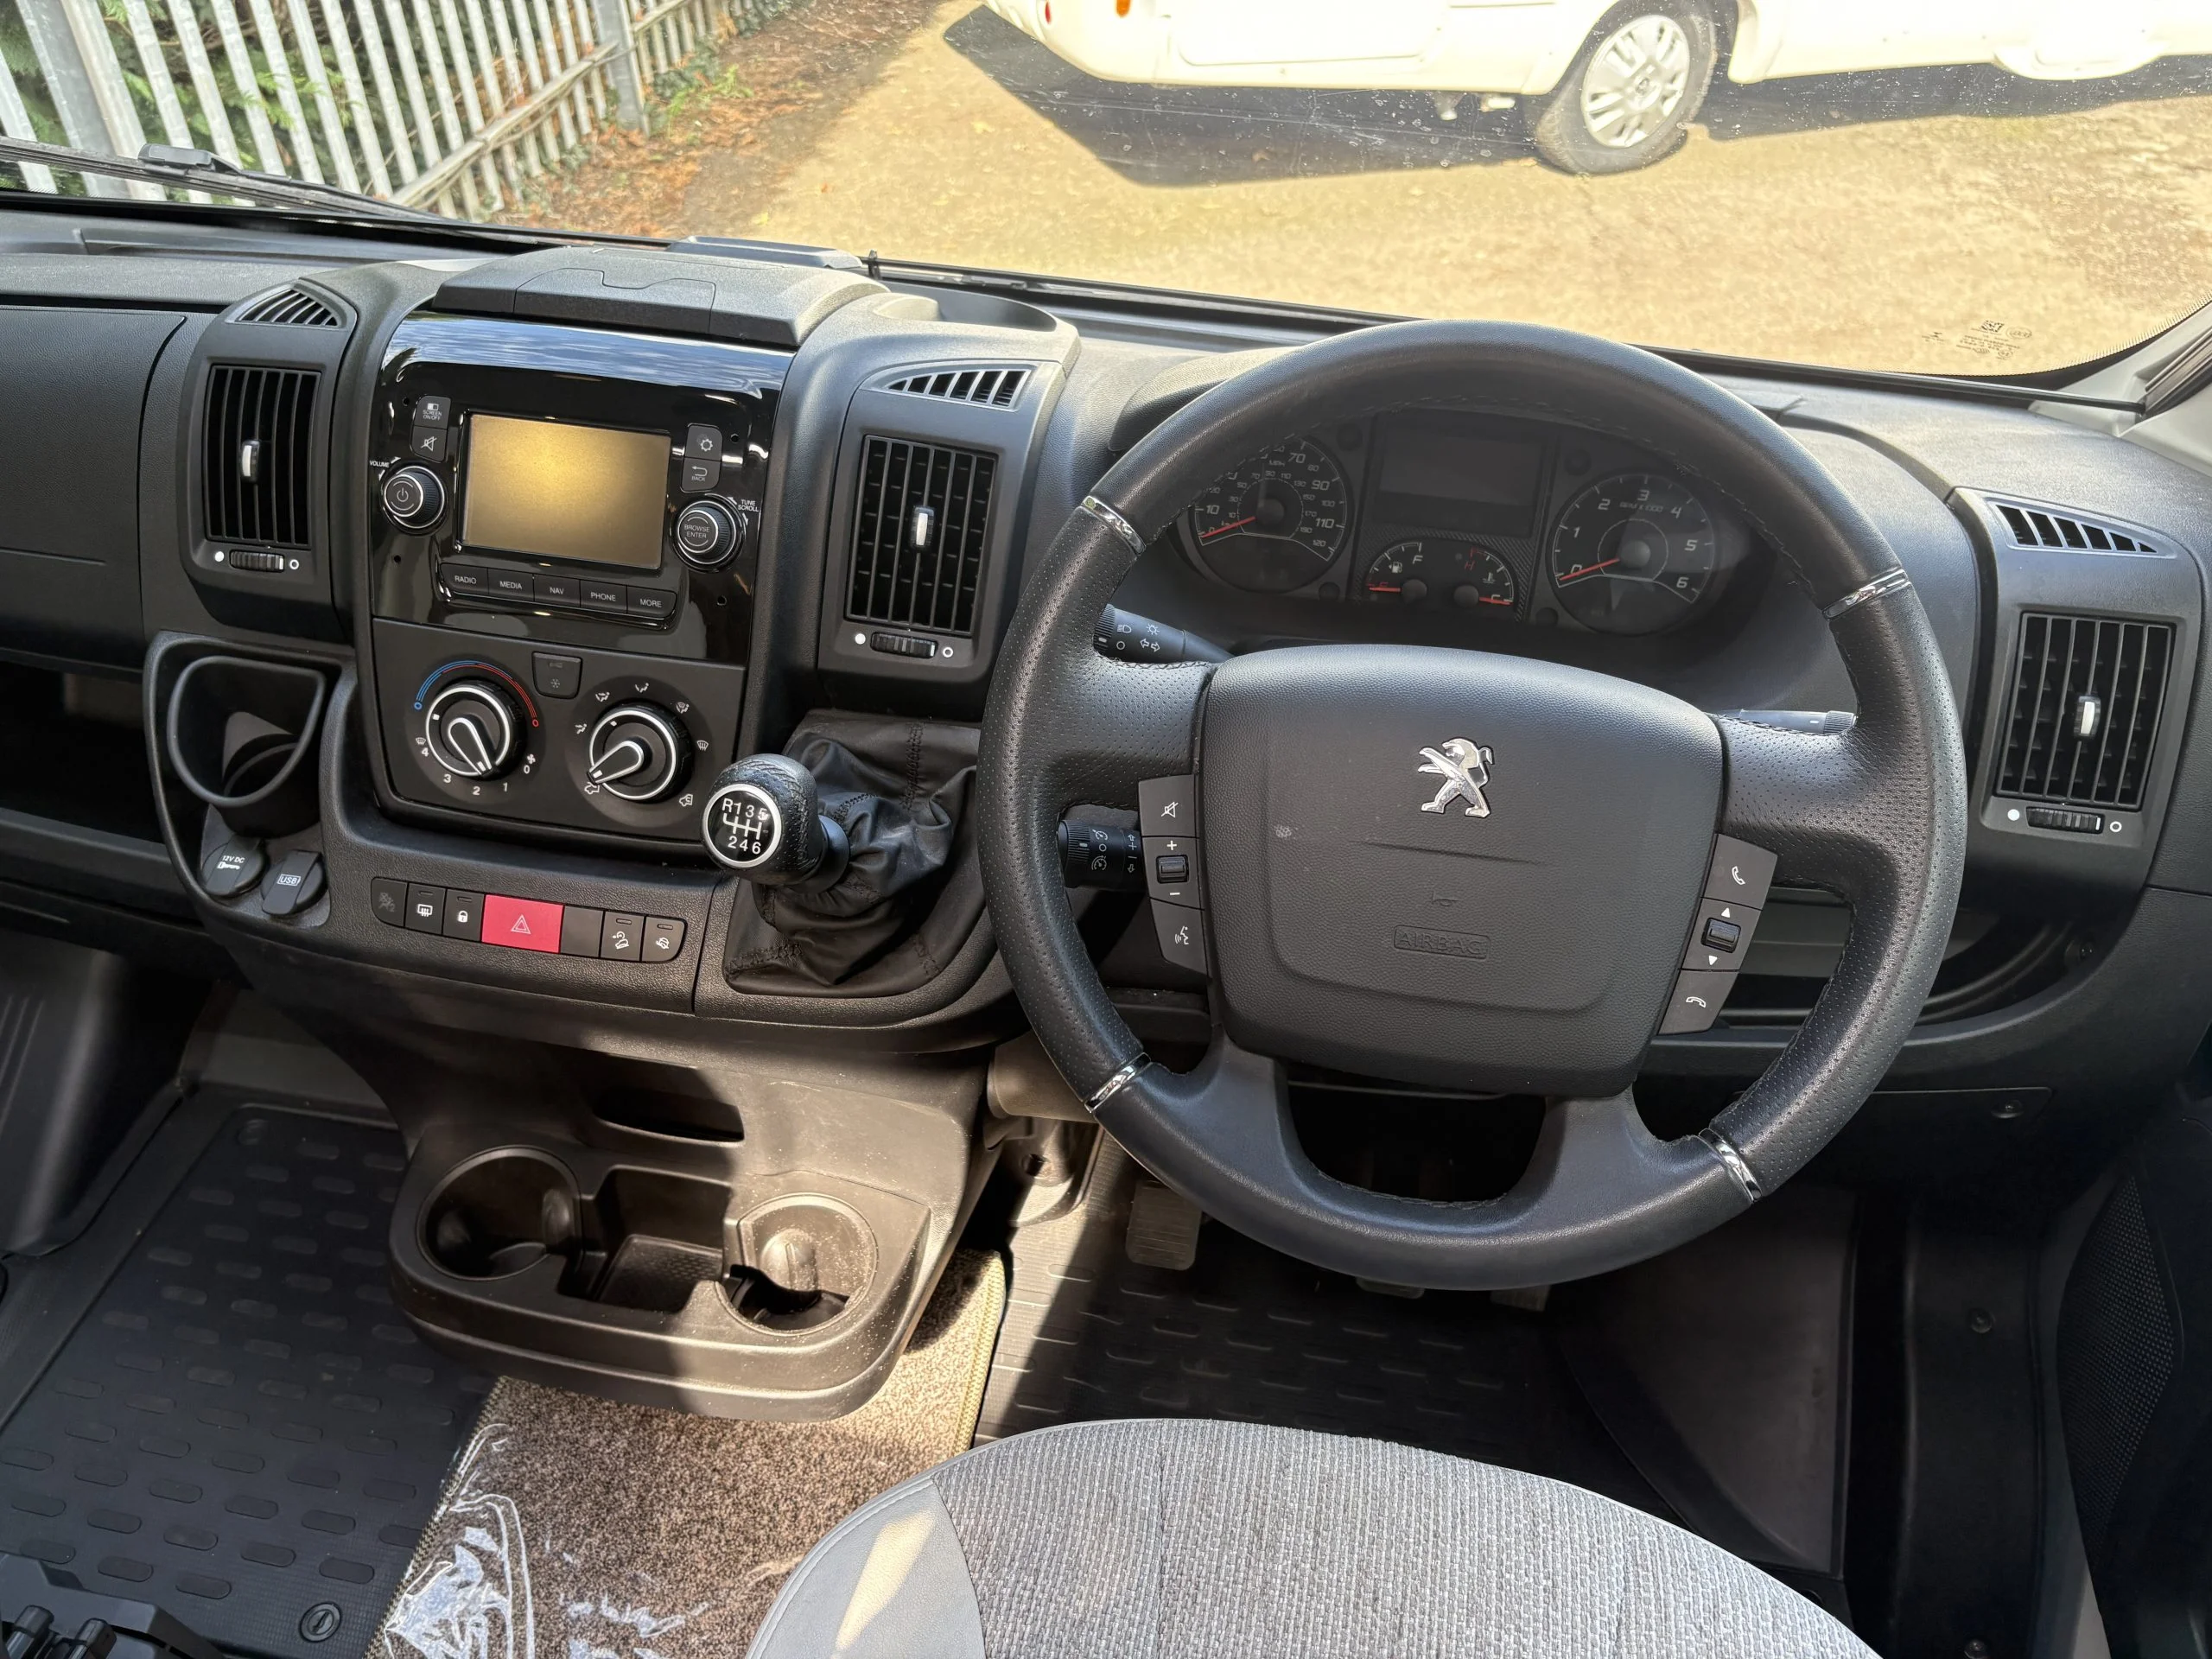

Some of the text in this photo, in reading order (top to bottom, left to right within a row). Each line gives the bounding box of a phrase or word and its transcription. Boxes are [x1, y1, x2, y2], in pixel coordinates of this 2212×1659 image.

[1288, 452, 1306, 464] 70
[1311, 480, 1330, 491] 90
[1637, 489, 1649, 501] 3
[1598, 498, 1611, 511] 2
[1206, 505, 1220, 515] 10
[1670, 506, 1682, 518] 4
[683, 524, 710, 533] BROWSE
[1315, 518, 1335, 529] 110
[1573, 526, 1580, 538] 1
[1684, 539, 1698, 552] 5
[1412, 555, 1424, 564] F
[1464, 561, 1476, 571] H
[454, 575, 477, 584] RADIO
[1675, 576, 1689, 588] 6
[499, 581, 523, 589] MEDIA
[590, 592, 616, 602] PHONE
[639, 598, 662, 608] MORE
[422, 747, 429, 757] 4
[524, 765, 531, 774] 0
[443, 773, 452, 783] 3
[473, 785, 480, 796] 2
[503, 782, 508, 792] 1
[721, 798, 768, 821] R 1 3 5
[728, 836, 762, 855] 2 4 6
[280, 875, 298, 885] USB
[1399, 932, 1484, 956] AIRBAG
